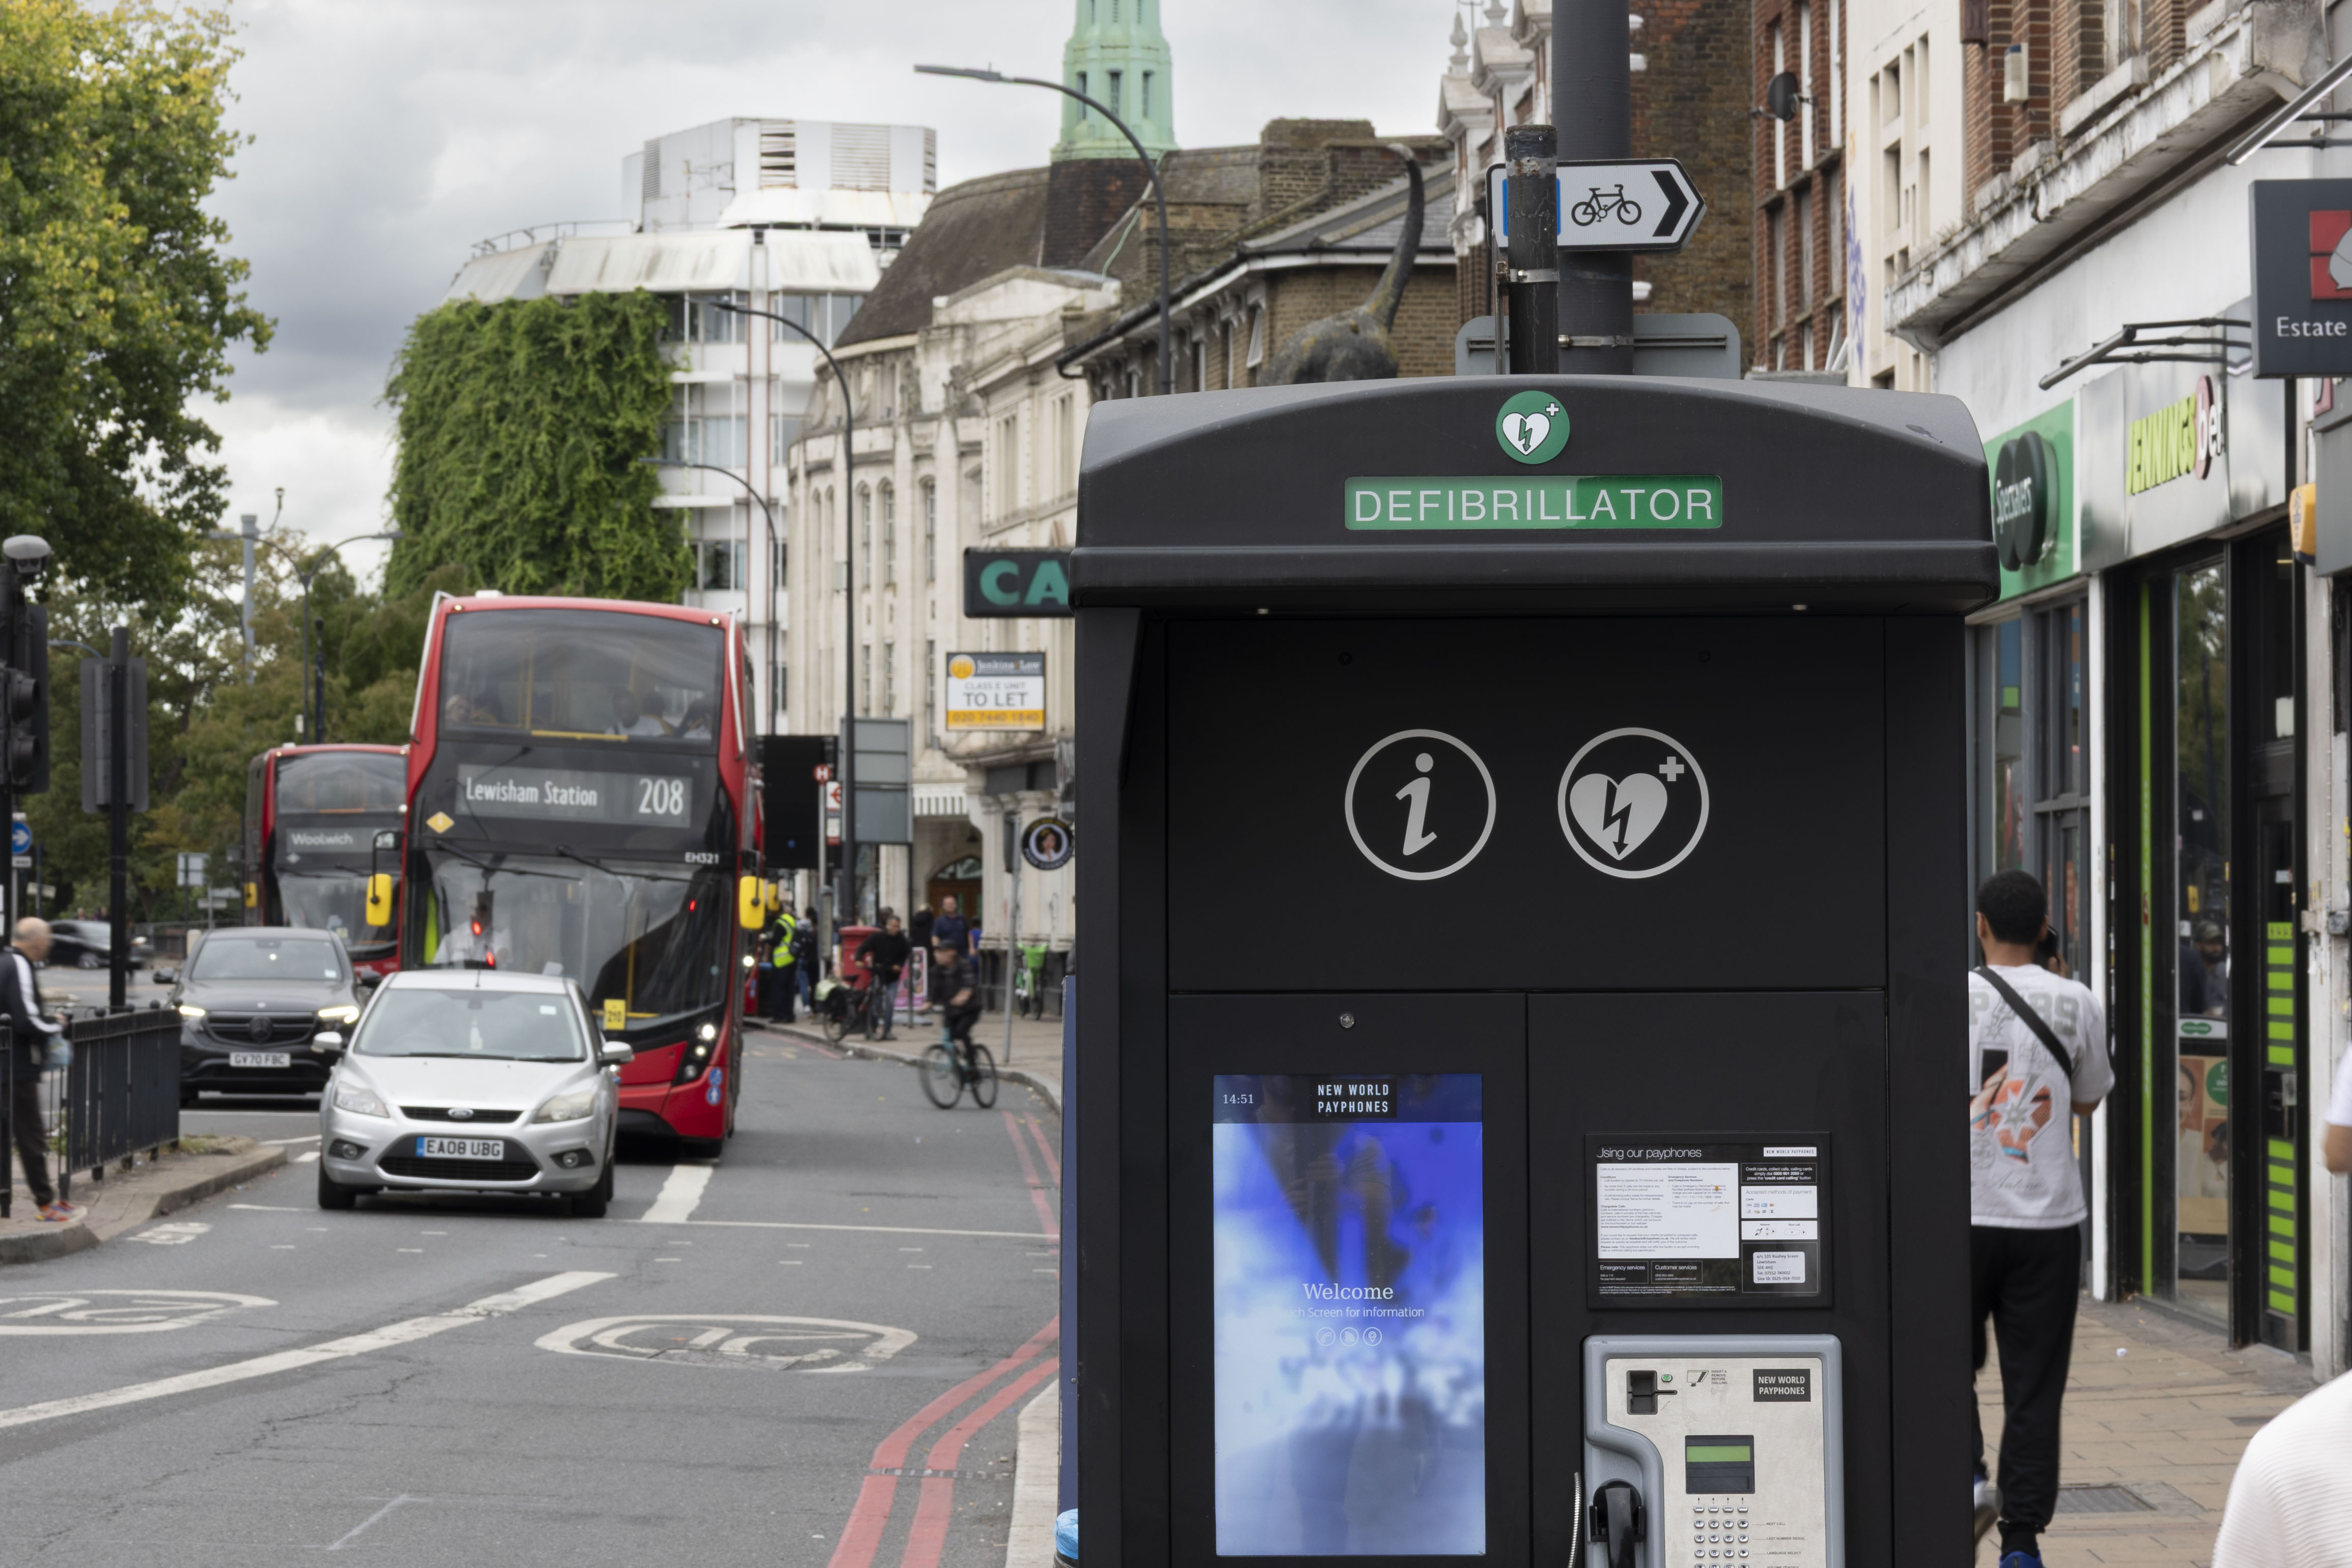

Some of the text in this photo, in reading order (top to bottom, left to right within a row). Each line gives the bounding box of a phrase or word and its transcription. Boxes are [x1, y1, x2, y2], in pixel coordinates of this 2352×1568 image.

[2277, 316, 2347, 337] Estate
[2126, 393, 2196, 496] JENNINGS
[1355, 489, 1713, 521] DEFIBRILLATOR
[1996, 477, 2032, 535] Specsavers
[963, 692, 1028, 707] TO LET
[816, 767, 829, 780] H
[466, 777, 684, 815] Lewisham Station 208
[291, 832, 353, 845] Woolwich
[685, 852, 719, 864] EH321
[1318, 1084, 1389, 1096] NEW WORLD
[1223, 1094, 1254, 1104] 14:51
[1318, 1102, 1389, 1112] PAYPHONES
[426, 1140, 466, 1155] EA08
[471, 1143, 500, 1157] UBG
[1646, 1147, 1702, 1160] payphones
[1302, 1283, 1394, 1299] Welcome
[1308, 1307, 1343, 1317] Screen
[1346, 1307, 1360, 1317] for
[1363, 1307, 1424, 1317] information
[1778, 1376, 1805, 1384] WORLD
